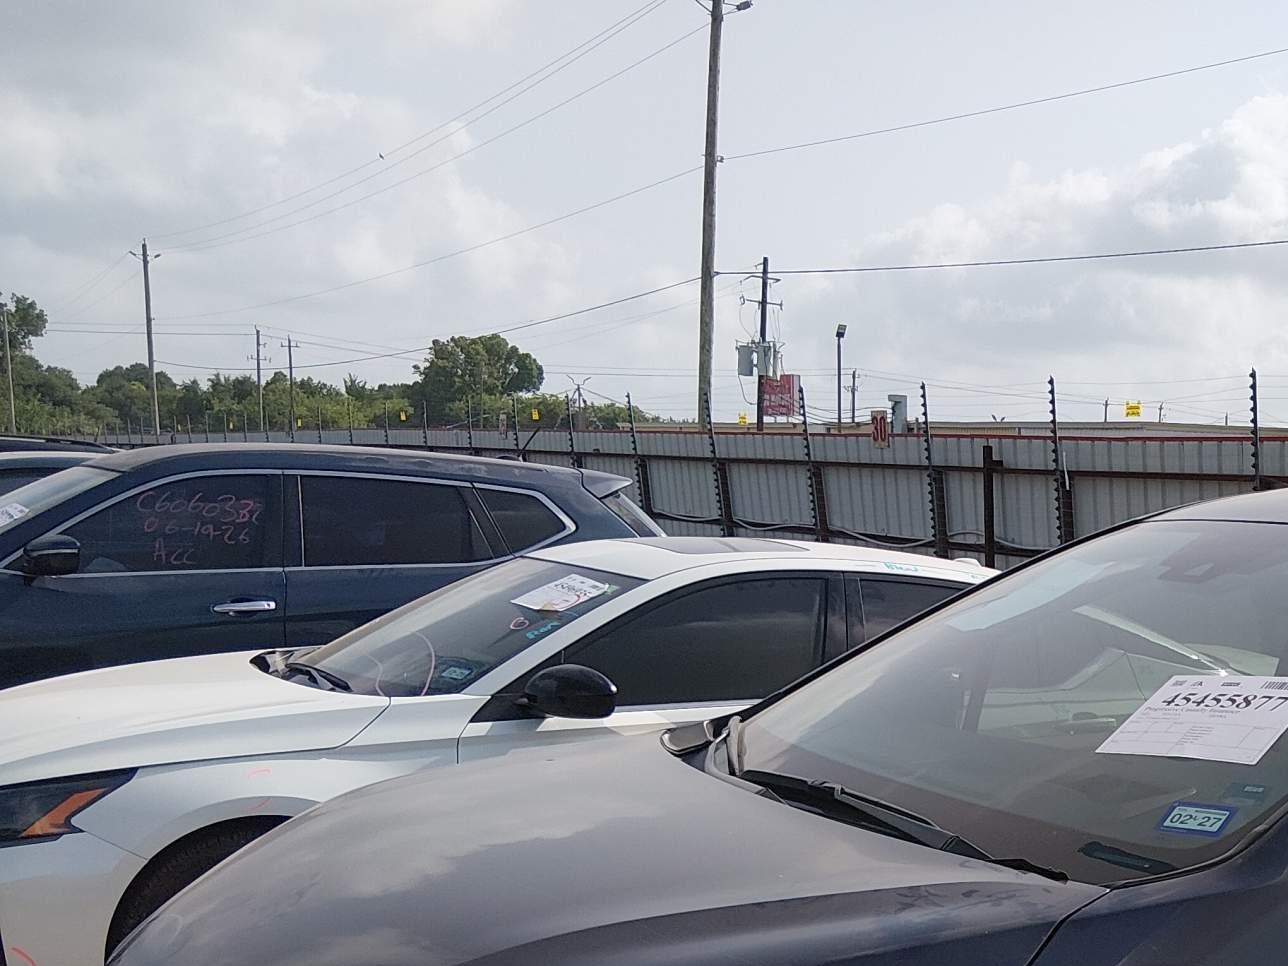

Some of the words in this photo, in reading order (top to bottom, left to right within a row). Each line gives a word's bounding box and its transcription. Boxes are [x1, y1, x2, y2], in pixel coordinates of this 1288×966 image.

[872, 415, 887, 442] 30
[1169, 813, 1193, 826] 02
[1197, 815, 1222, 828] 27
